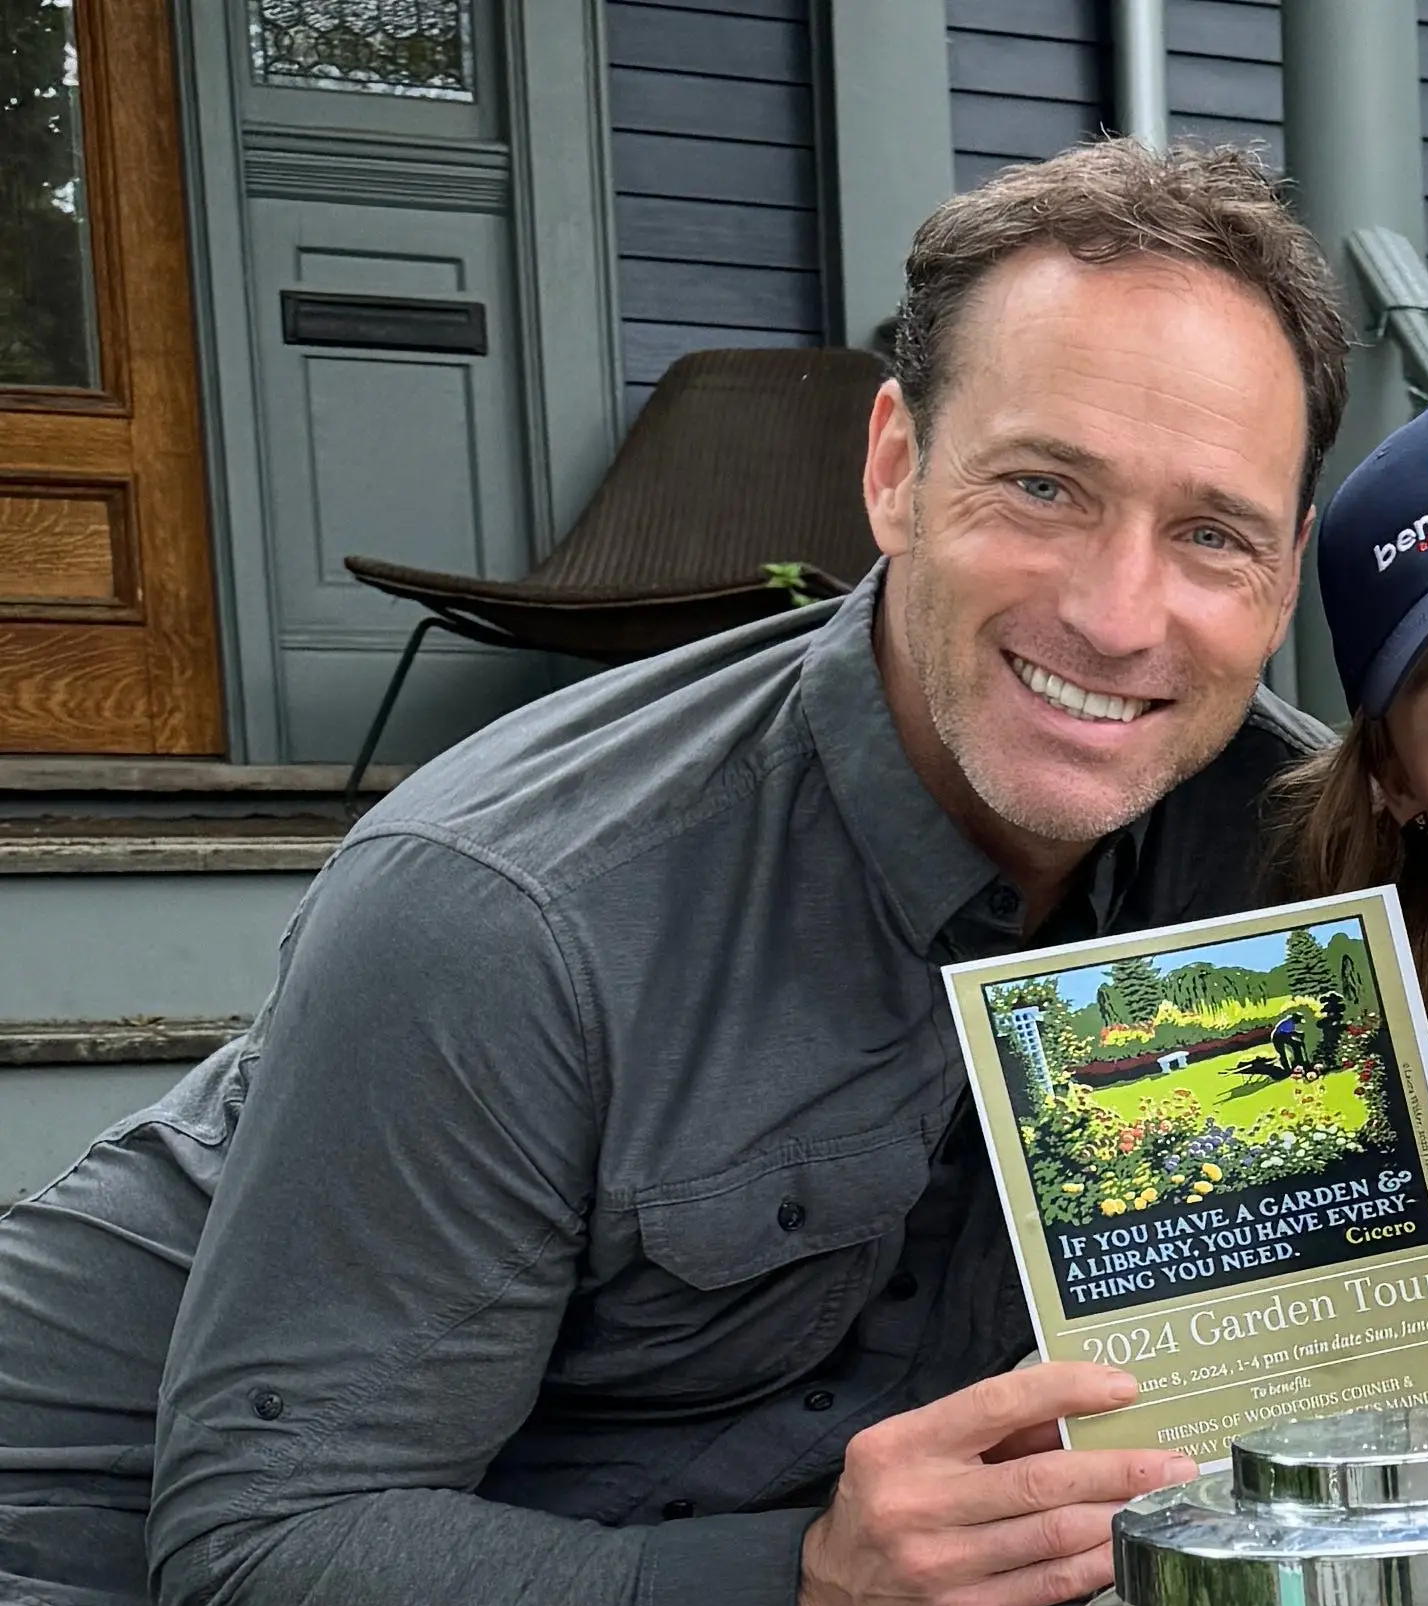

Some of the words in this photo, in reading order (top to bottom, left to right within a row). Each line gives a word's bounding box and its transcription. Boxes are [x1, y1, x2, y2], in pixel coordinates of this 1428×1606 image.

[1059, 1234, 1086, 1259] IF
[1094, 1225, 1149, 1250] YOU
[1154, 1208, 1232, 1239] HAVE
[1236, 1203, 1254, 1222] A
[1259, 1179, 1370, 1215] GARDEN
[1377, 1170, 1412, 1193] &
[1066, 1262, 1085, 1281] A
[1089, 1238, 1200, 1277] LIBRARY,
[1201, 1227, 1254, 1254] YOU
[1258, 1209, 1323, 1241] HAVE
[1327, 1194, 1417, 1227] EVERY-
[1345, 1219, 1416, 1245] Cicero
[1070, 1272, 1155, 1303] THING
[1160, 1258, 1216, 1284] YOU
[1222, 1242, 1301, 1272] NEED.
[1082, 1320, 1180, 1366] 2024
[1190, 1293, 1338, 1346] Garden
[1137, 1375, 1169, 1395] une
[1190, 1364, 1233, 1384] 2024,
[1236, 1356, 1260, 1374] 1-4
[1263, 1348, 1290, 1369] pm
[1293, 1341, 1329, 1362] (rain
[1331, 1332, 1362, 1352] date
[1157, 1420, 1219, 1444] FRIENDS
[1221, 1413, 1242, 1429] OF
[1245, 1390, 1339, 1424] WOODFORDS
[1342, 1376, 1401, 1403] CORNER
[1403, 1374, 1415, 1388] &
